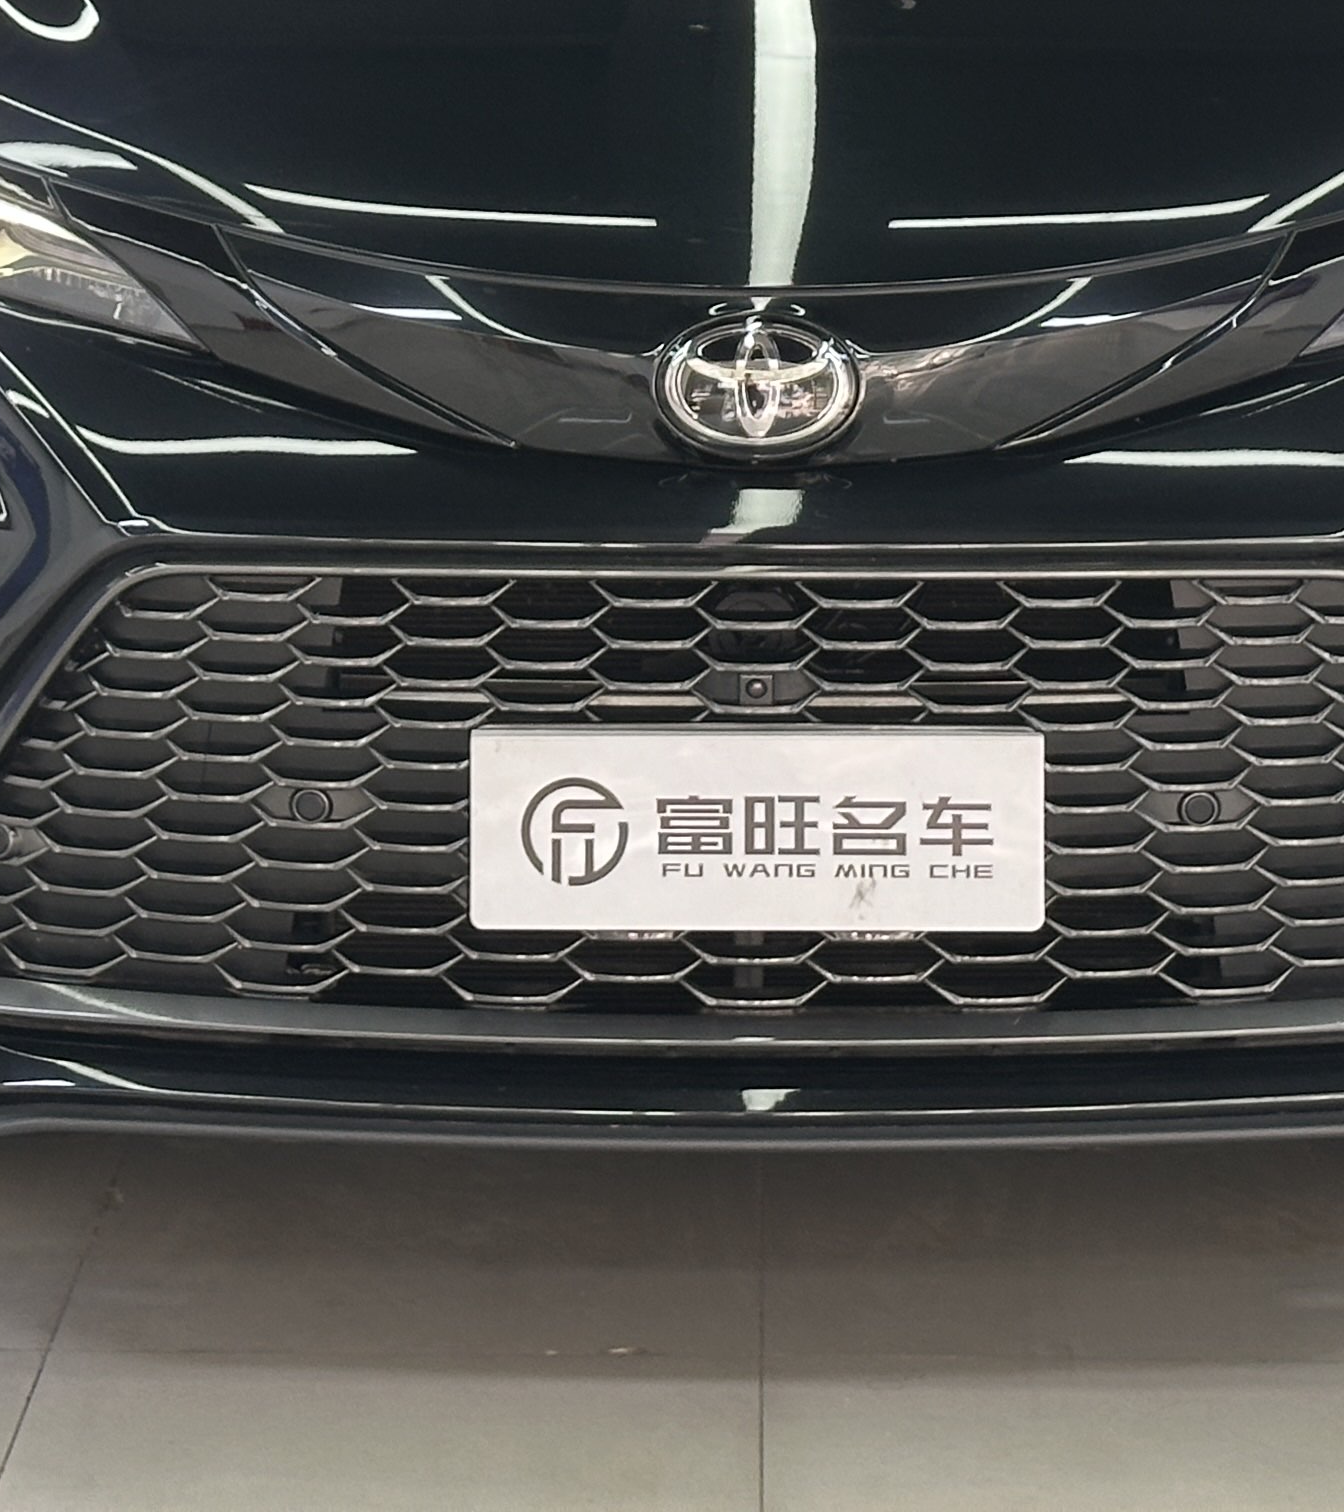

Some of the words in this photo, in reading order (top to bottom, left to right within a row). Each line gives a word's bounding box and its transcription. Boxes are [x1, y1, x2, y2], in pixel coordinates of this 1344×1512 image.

[656, 795, 995, 858] 富旺名车
[661, 863, 705, 879] FU
[725, 863, 816, 879] WANG
[834, 863, 911, 879] MING
[928, 863, 995, 879] CHE
